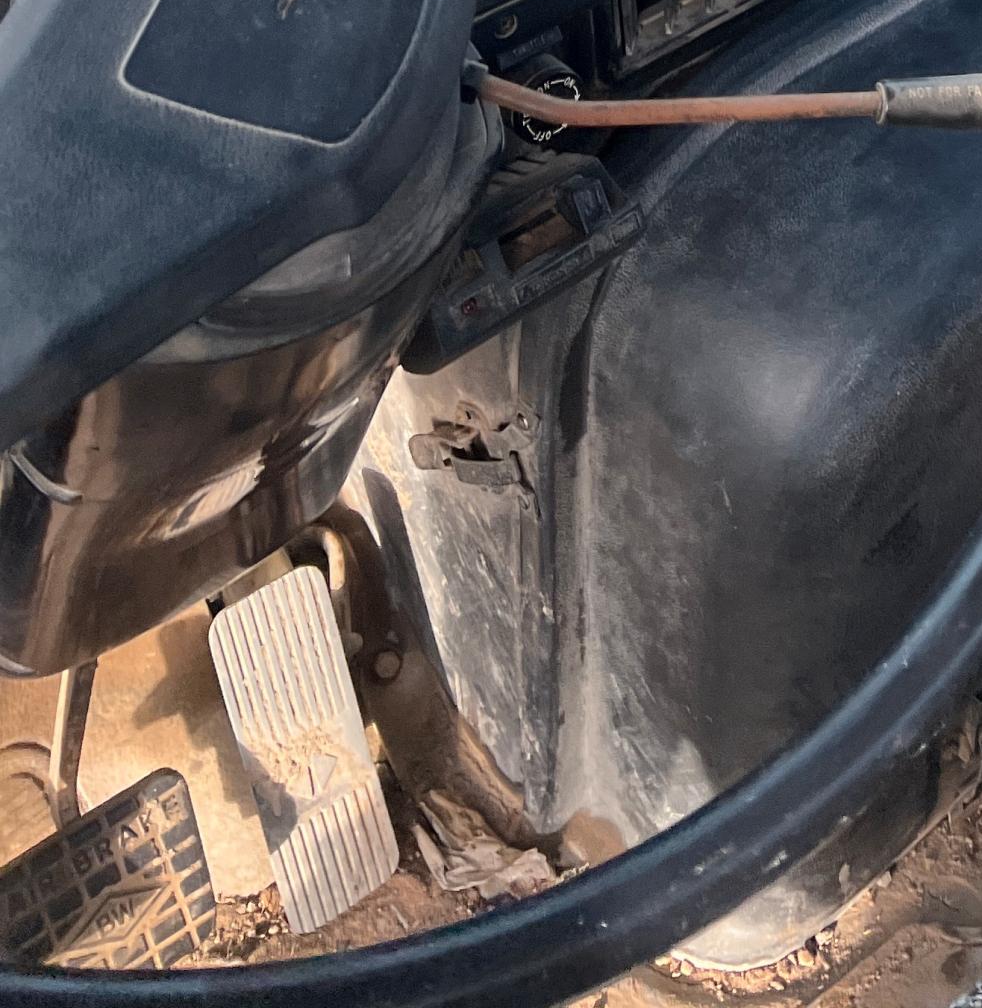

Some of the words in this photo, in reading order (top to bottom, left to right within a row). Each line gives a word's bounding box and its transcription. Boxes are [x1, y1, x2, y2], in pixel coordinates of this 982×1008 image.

[564, 76, 576, 88] ON
[908, 87, 931, 99] NOT
[938, 86, 962, 97] FOR
[533, 130, 552, 142] OFF
[72, 794, 179, 874] BRAKE
[95, 899, 136, 932] BW
